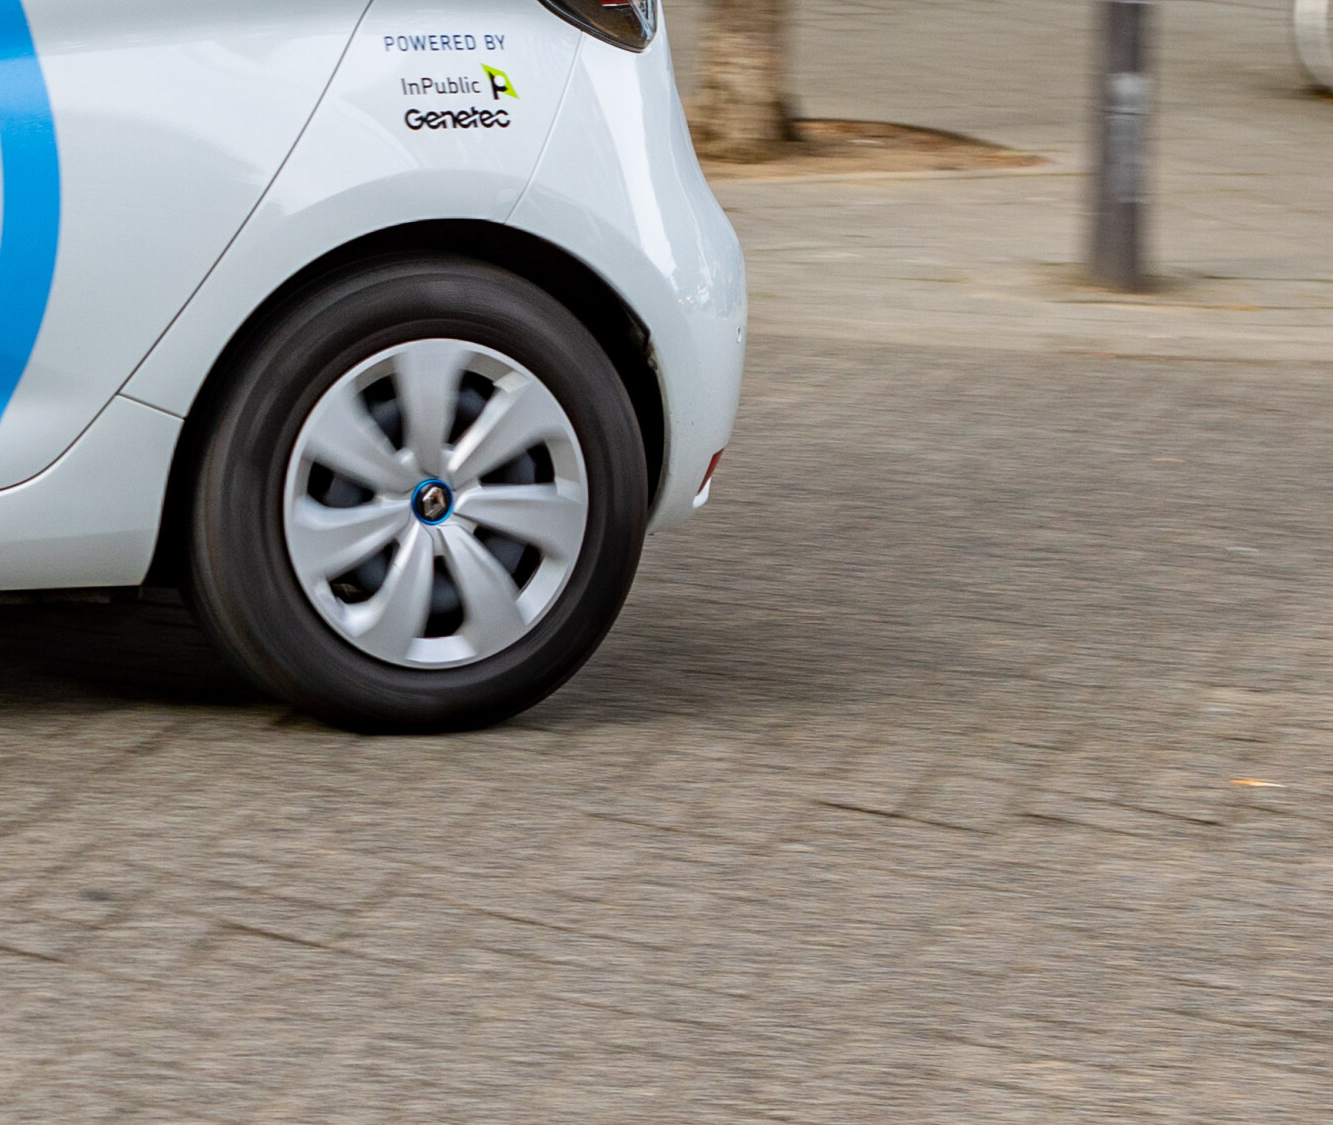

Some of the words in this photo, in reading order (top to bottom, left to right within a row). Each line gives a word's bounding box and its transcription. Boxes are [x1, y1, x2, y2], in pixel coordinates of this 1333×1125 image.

[384, 34, 477, 51] POWERED
[484, 34, 505, 51] BY
[400, 76, 482, 95] InPublic
[404, 106, 511, 130] Genetec
